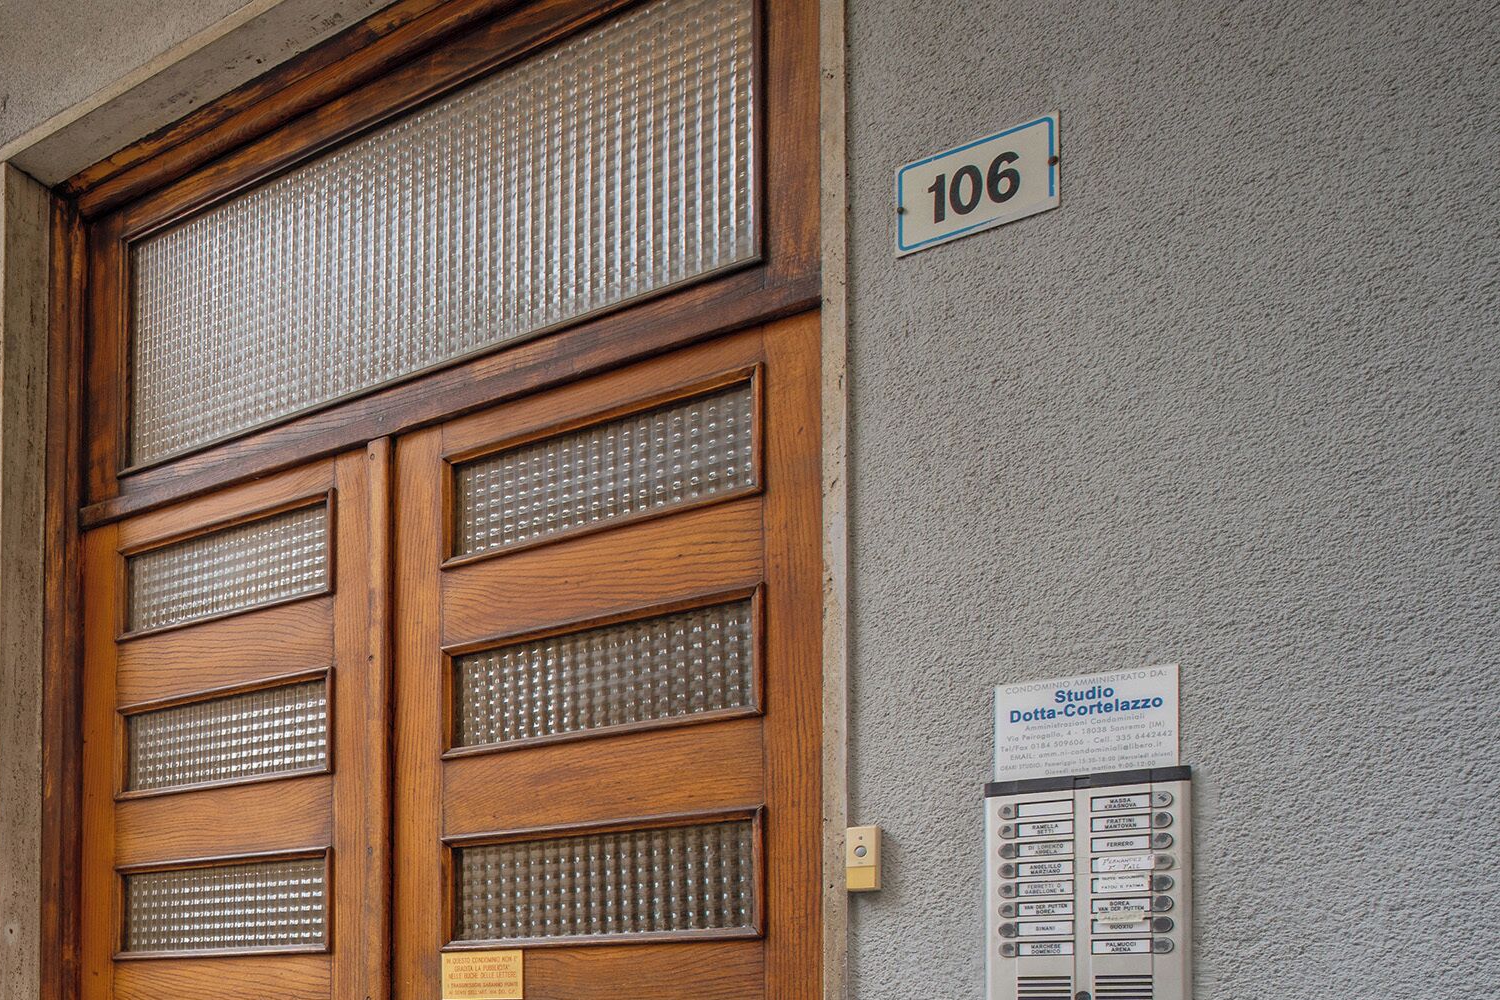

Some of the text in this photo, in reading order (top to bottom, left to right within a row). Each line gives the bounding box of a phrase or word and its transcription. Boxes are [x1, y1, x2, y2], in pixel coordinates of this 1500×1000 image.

[927, 151, 1020, 224] 106
[1005, 670, 1167, 695] CONDOMINIO AMMINISTRATO DA:
[1055, 686, 1114, 703] Studio
[1010, 696, 1163, 723] Dotta-Cortelazzo
[1006, 734, 1020, 742] Via
[1082, 726, 1107, 735] 18038
[1110, 722, 1145, 732] Sanremo
[1148, 720, 1165, 729] (IM)
[1025, 713, 1145, 732] Amministrazioni Condominiali
[1001, 743, 1028, 753] Tel/Fax
[1031, 742, 1050, 750] 0184
[1116, 733, 1131, 742] 335
